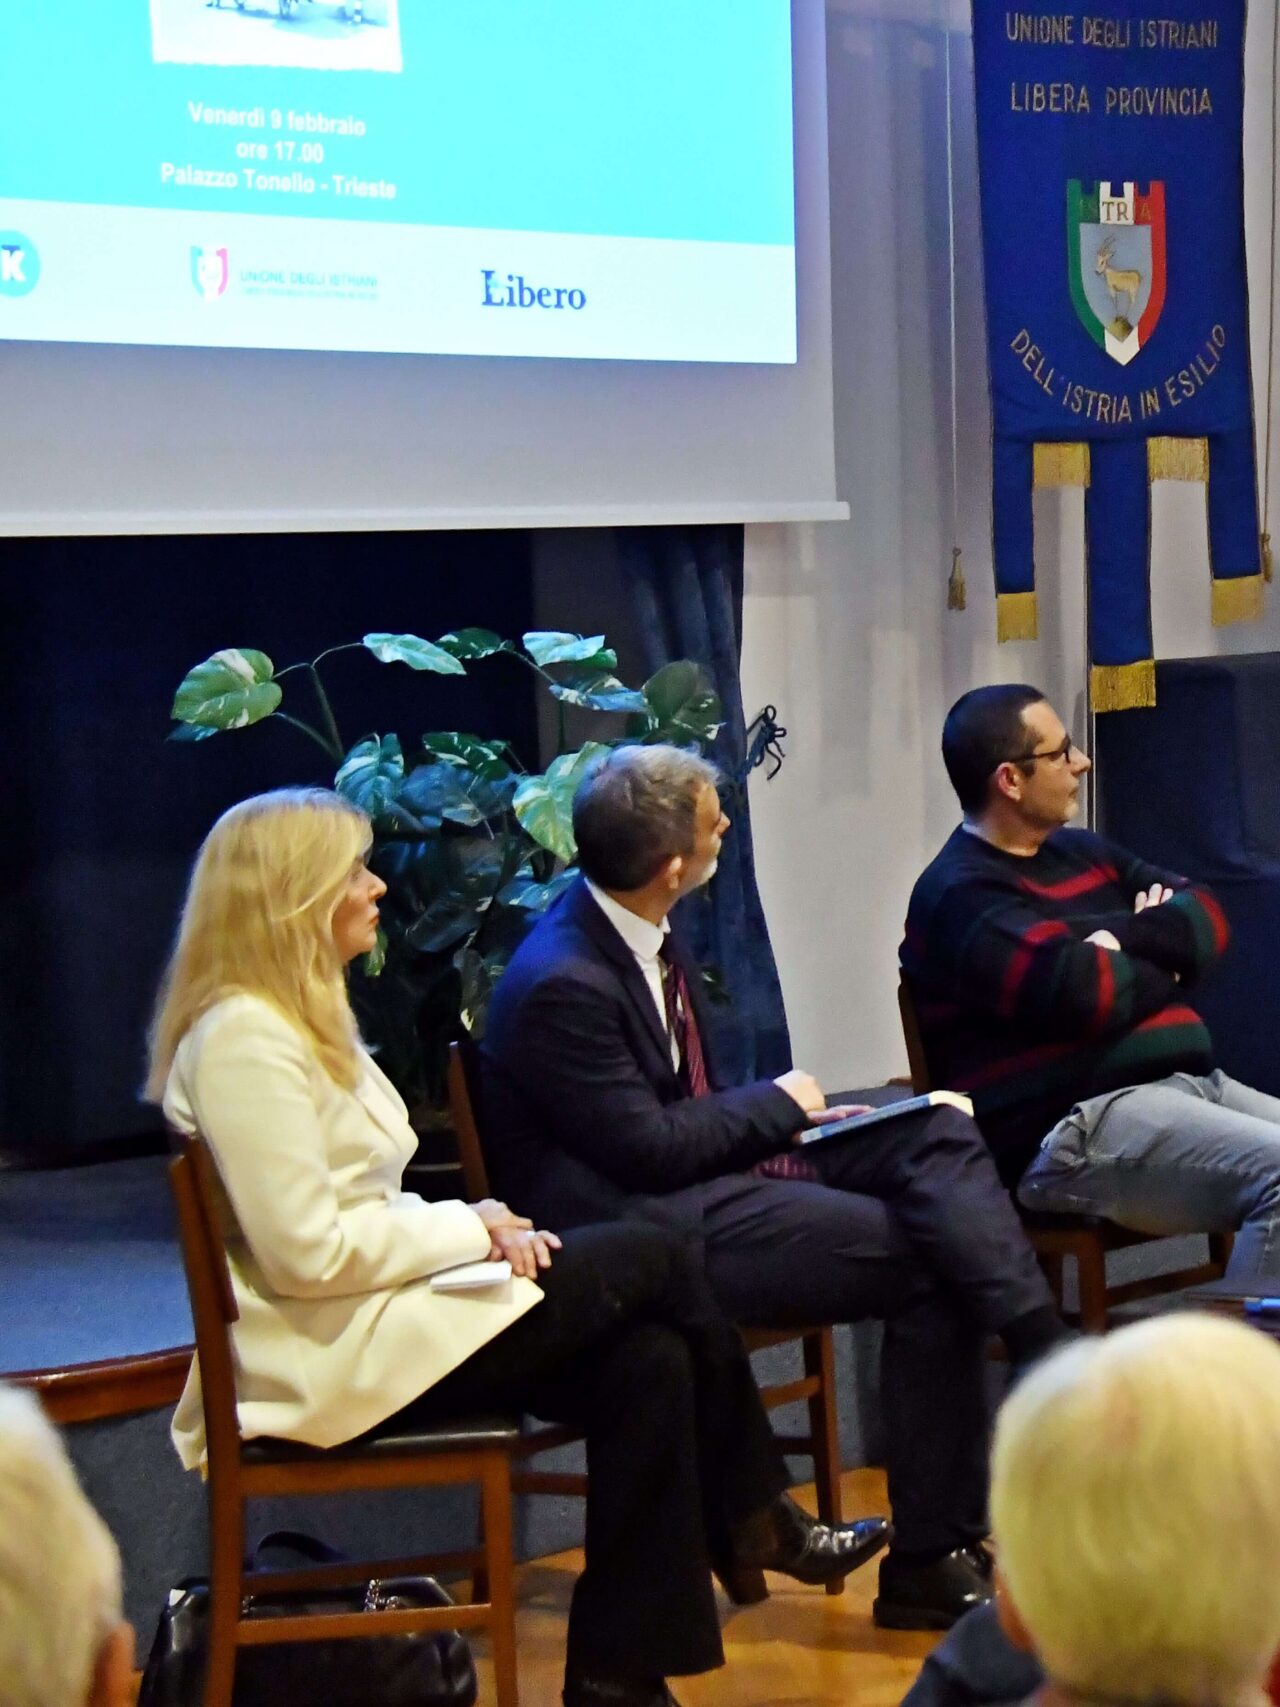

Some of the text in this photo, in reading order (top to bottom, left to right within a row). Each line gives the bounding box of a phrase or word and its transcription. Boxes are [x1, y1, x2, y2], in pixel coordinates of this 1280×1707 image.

[1006, 12, 1218, 49] UNIONE DEGLI ISTRIANI
[1011, 82, 1213, 116] LIBERA PROVINCIA
[270, 108, 283, 130] 9
[288, 111, 367, 137] febbraio
[236, 141, 325, 164] ore 17.00
[160, 162, 238, 189] Palazzo
[243, 168, 316, 193] Tonello
[332, 175, 398, 200] Trieste
[481, 269, 587, 311] Libero
[1140, 387, 1160, 420] IN
[1164, 324, 1226, 408] ESILIO
